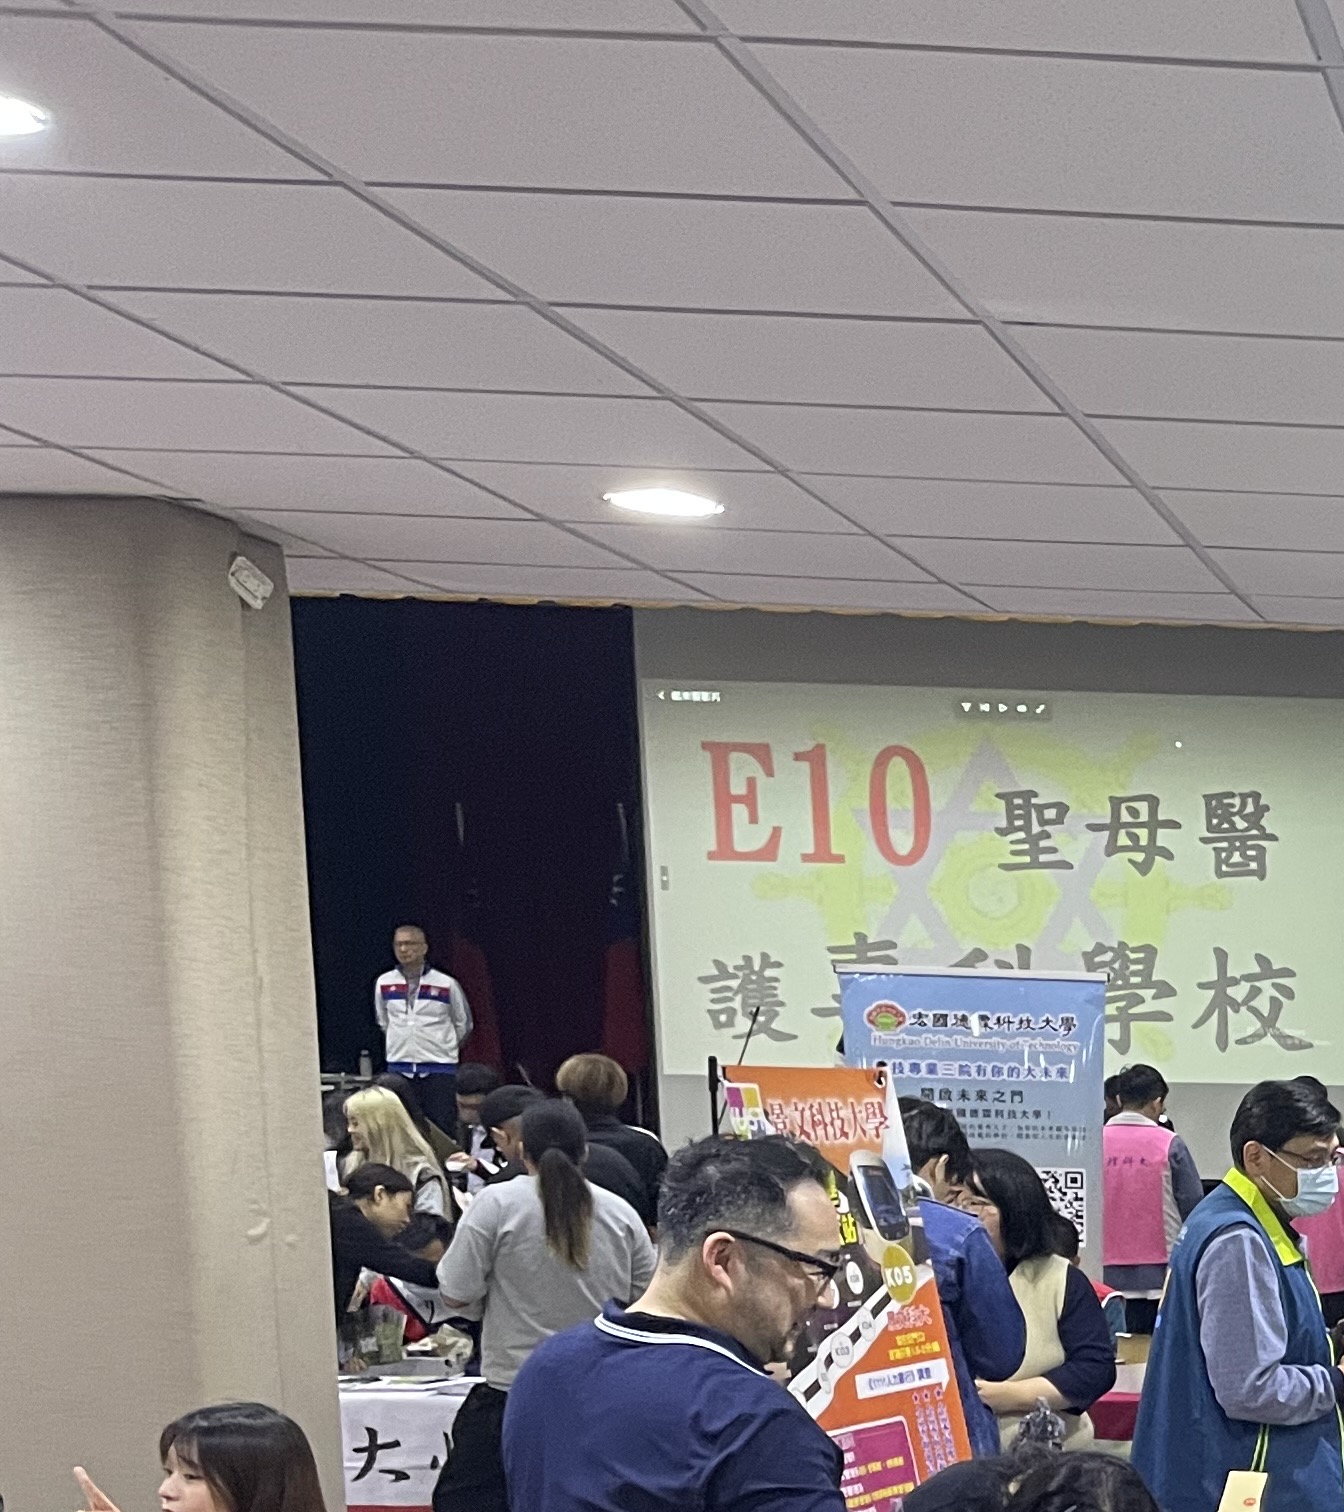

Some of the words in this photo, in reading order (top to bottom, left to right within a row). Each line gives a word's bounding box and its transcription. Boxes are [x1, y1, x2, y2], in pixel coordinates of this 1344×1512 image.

[700, 740, 932, 867] E10
[994, 789, 1279, 882] 聖母醫
[698, 932, 1315, 1053] 護學校
[954, 1037, 1006, 1052] University
[885, 1266, 913, 1287] K05
